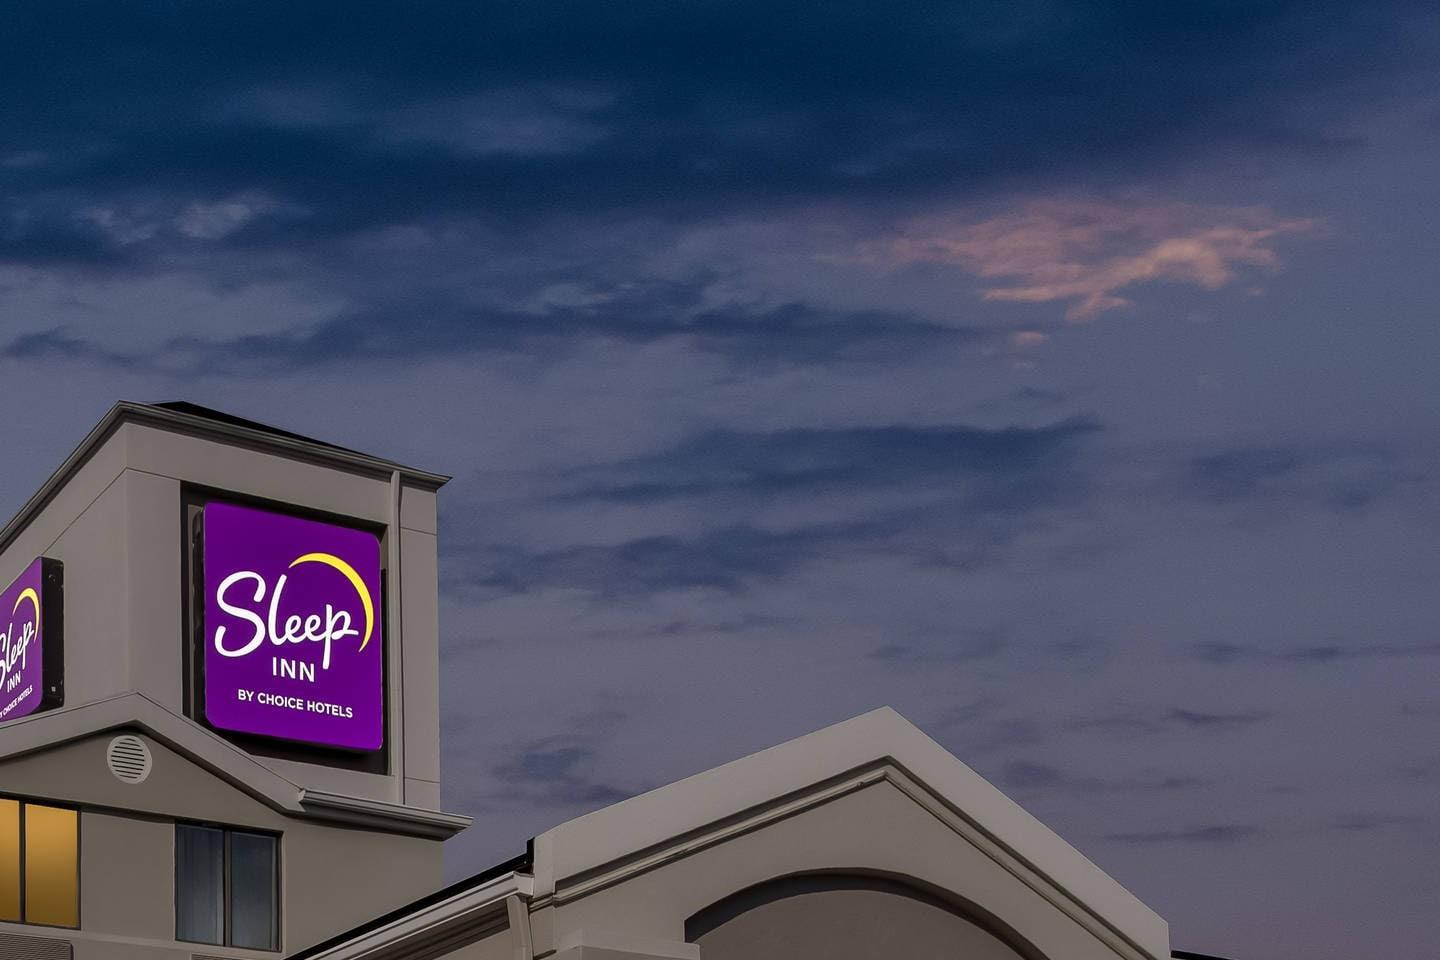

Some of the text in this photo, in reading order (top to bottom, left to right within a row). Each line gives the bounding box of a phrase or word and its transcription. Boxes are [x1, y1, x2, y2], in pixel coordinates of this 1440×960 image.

[214, 571, 359, 670] Sleep
[7, 670, 21, 693] INN
[272, 656, 315, 683] INN
[2, 698, 18, 716] CHOICE
[17, 684, 33, 704] HOTELS
[237, 688, 353, 718] BY CHOICE HOTELS
